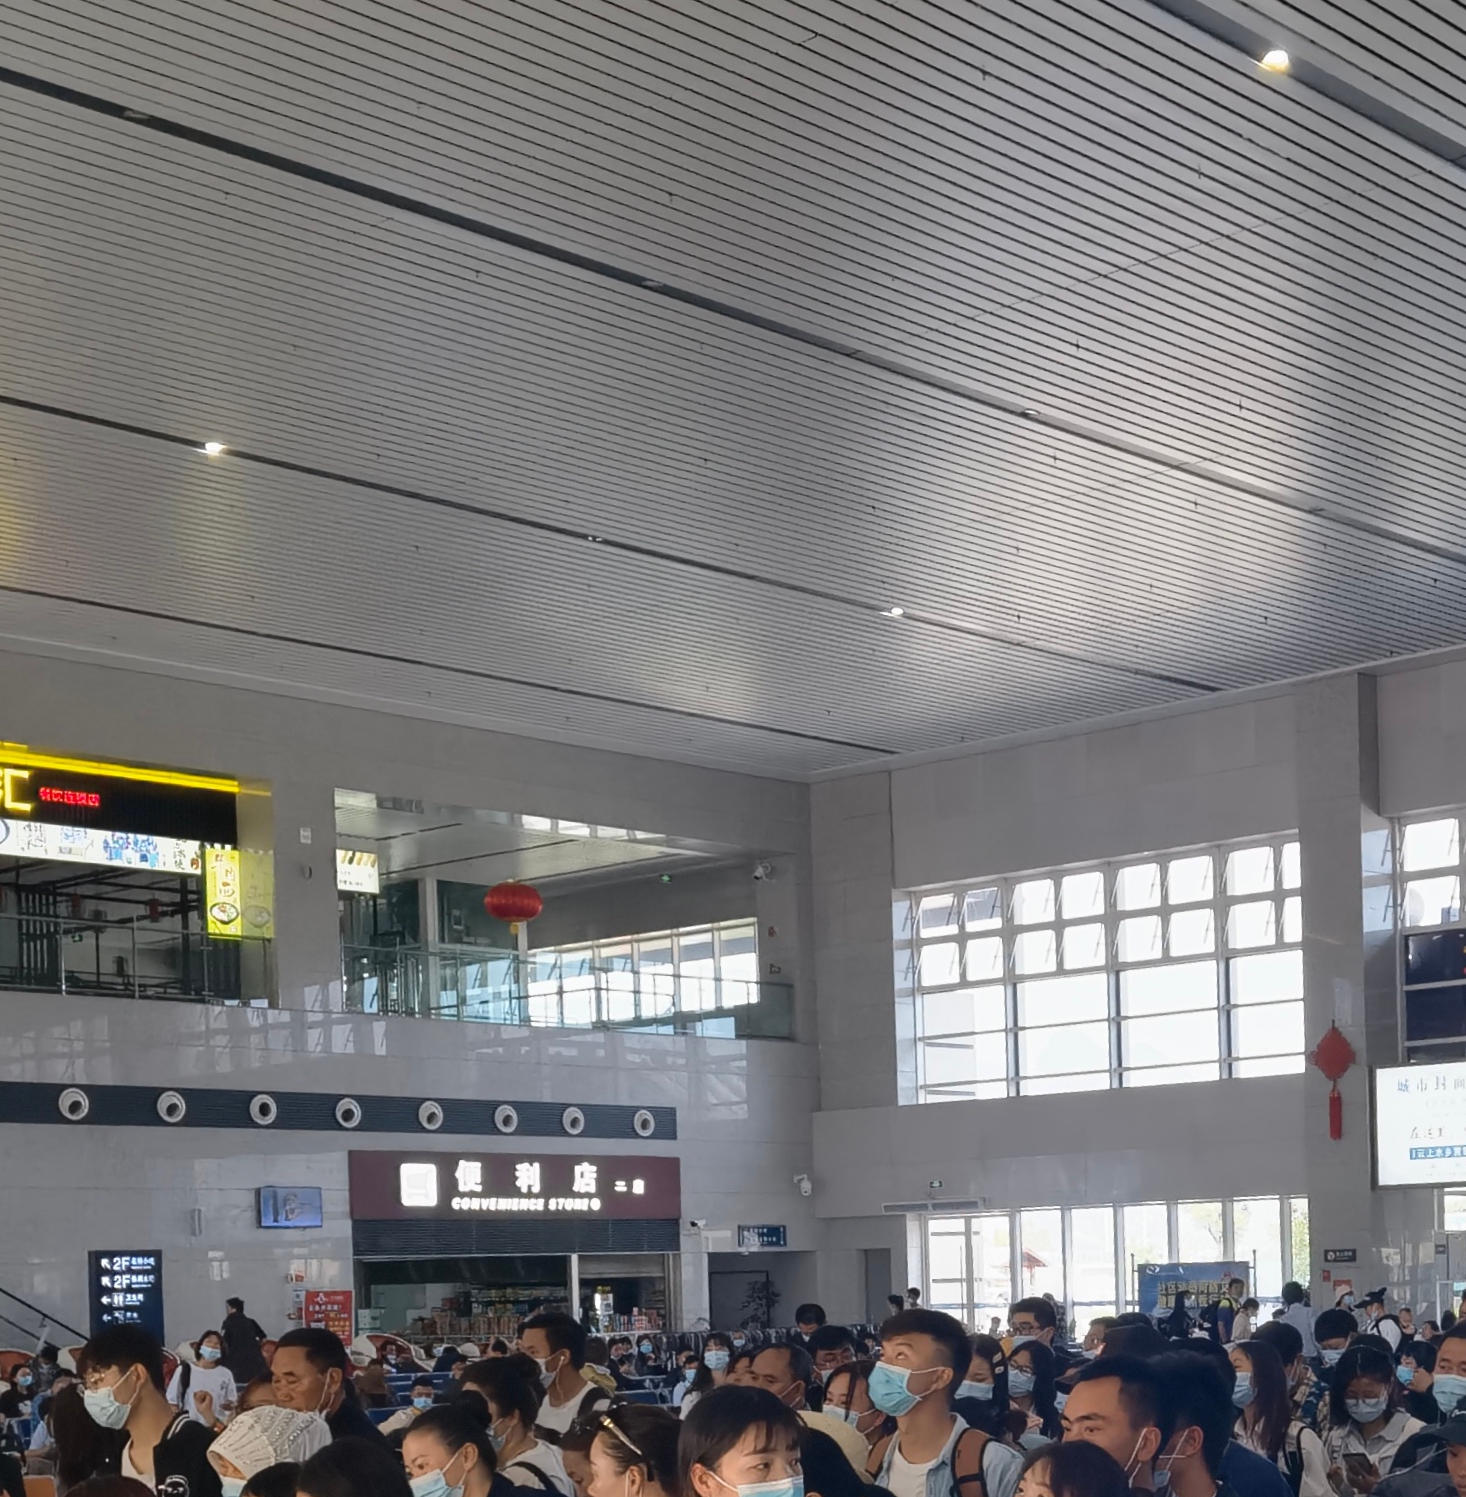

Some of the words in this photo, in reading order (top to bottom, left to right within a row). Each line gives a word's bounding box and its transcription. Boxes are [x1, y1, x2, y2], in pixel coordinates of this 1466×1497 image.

[455, 1160, 598, 1194] 便利店
[451, 1198, 545, 1211] CONVENIENCE
[548, 1198, 589, 1211] STORE
[113, 1257, 130, 1271] 2F
[114, 1275, 130, 1289] 2F
